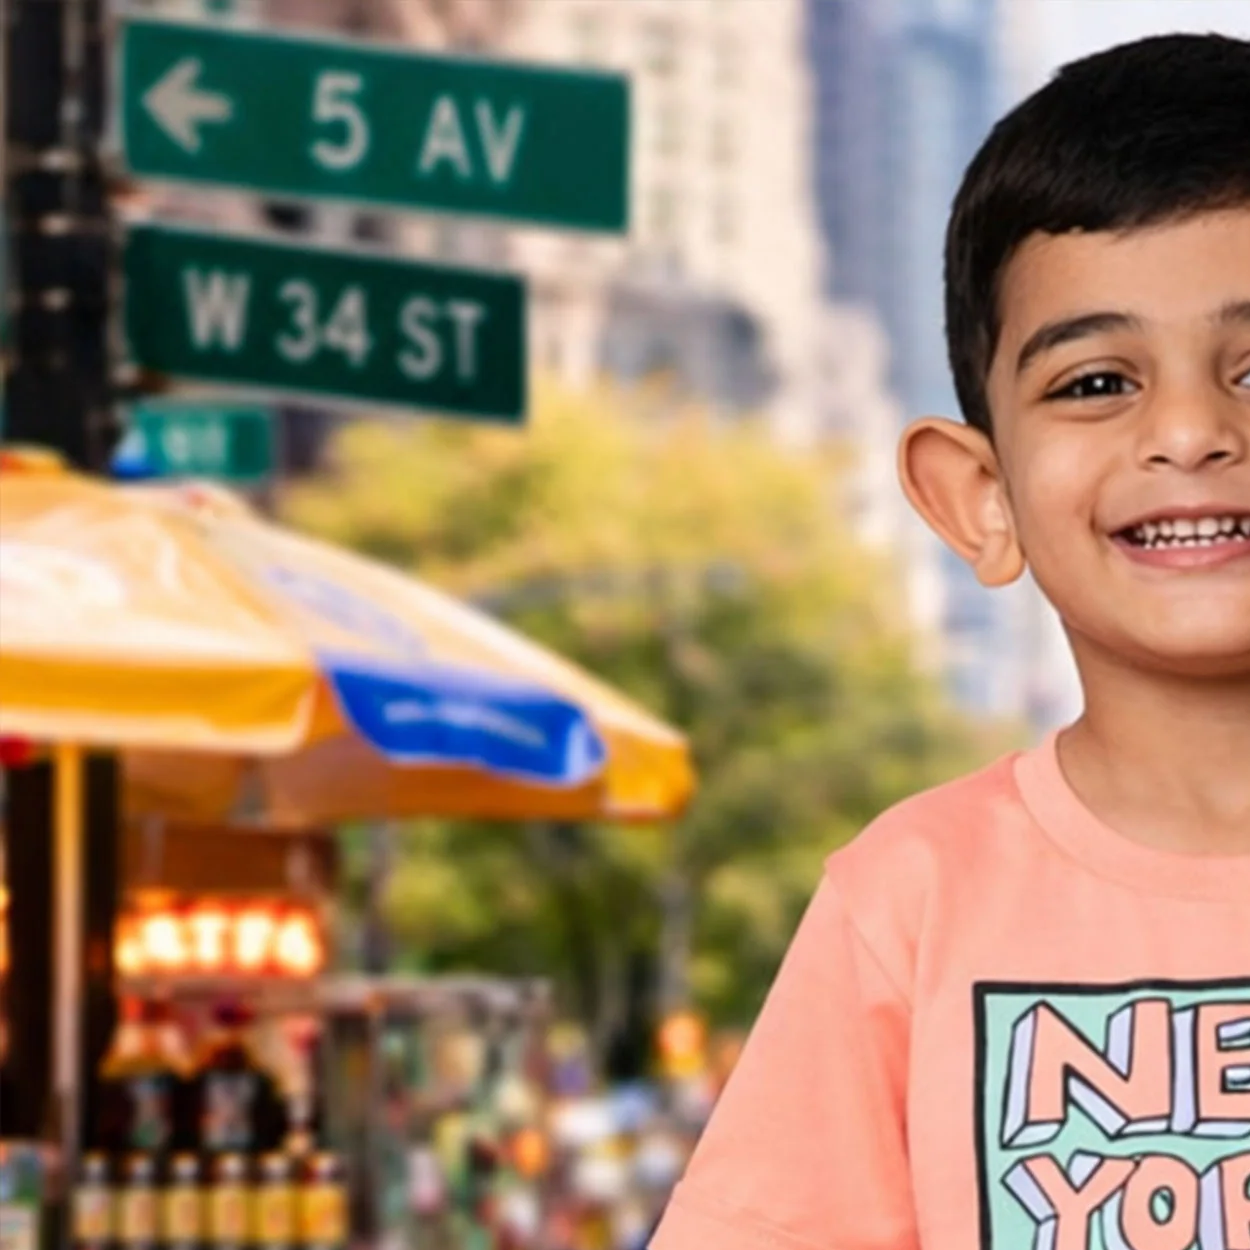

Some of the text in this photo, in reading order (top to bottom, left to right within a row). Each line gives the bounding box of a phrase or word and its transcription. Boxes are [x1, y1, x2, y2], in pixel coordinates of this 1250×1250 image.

[310, 70, 525, 183] 5 AV
[183, 268, 486, 378] W 34 ST
